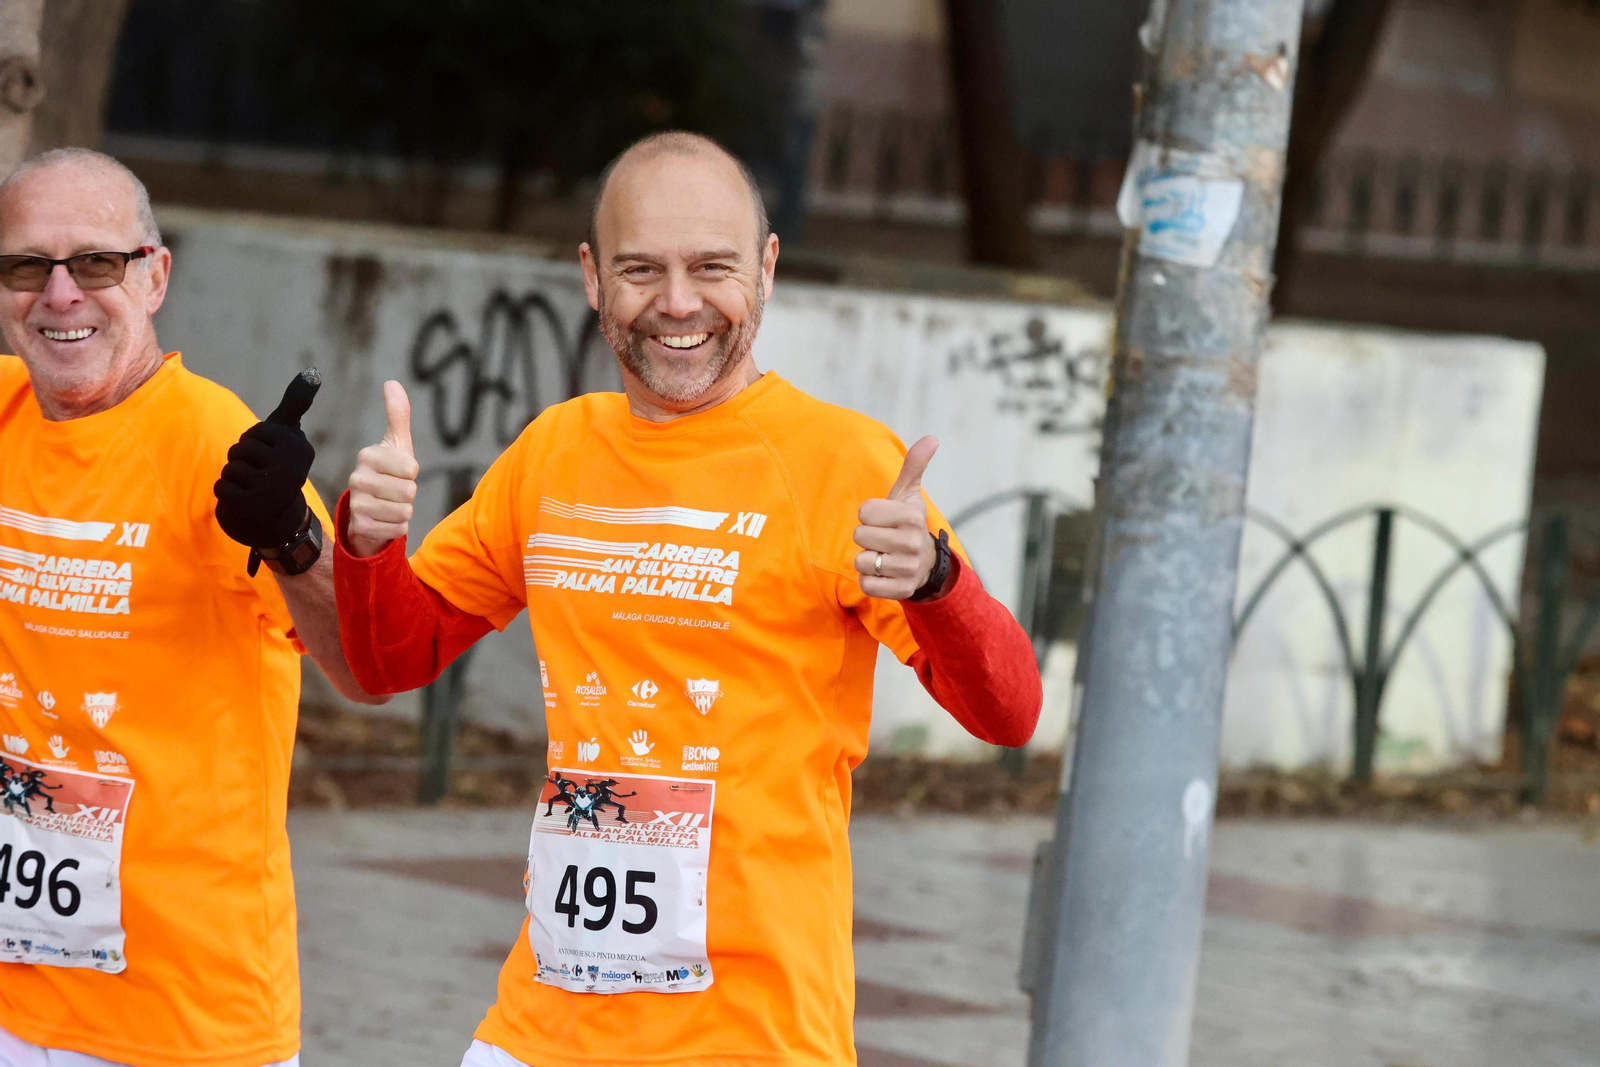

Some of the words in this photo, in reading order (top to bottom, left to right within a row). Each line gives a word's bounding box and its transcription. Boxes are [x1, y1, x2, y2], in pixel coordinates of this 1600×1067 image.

[727, 511, 768, 538] XII
[115, 522, 150, 547] XII
[632, 541, 740, 570] CARRERA
[33, 554, 132, 580] CARRERA
[600, 558, 638, 575] SAN
[635, 559, 739, 586] SILVESTRE
[11, 567, 37, 586] SAN
[38, 573, 132, 596] SILVESTRE
[553, 570, 617, 594] PALMA
[620, 575, 732, 606] PALMILLA
[29, 589, 130, 614] PALMILLA
[611, 610, 642, 622] MÁLAGA
[643, 614, 676, 625] CIUDAD
[677, 617, 730, 630] SALUDABLE
[48, 626, 76, 637] CIUDAD
[77, 630, 130, 639] SALUDABLE
[575, 685, 607, 695] ROSALEDA
[627, 700, 656, 708] Carrefour
[72, 803, 120, 822] XII
[647, 810, 705, 827] XII
[620, 822, 699, 834] CARRERA
[625, 829, 699, 839] SILVESTRE
[616, 834, 699, 846] PALMILLA
[555, 865, 658, 934] 495
[557, 948, 578, 957] ANTONIO
[579, 950, 596, 959] JESUS
[597, 952, 616, 960] PINTO
[616, 953, 647, 962] MEZCUA
[601, 969, 631, 981] málaga
